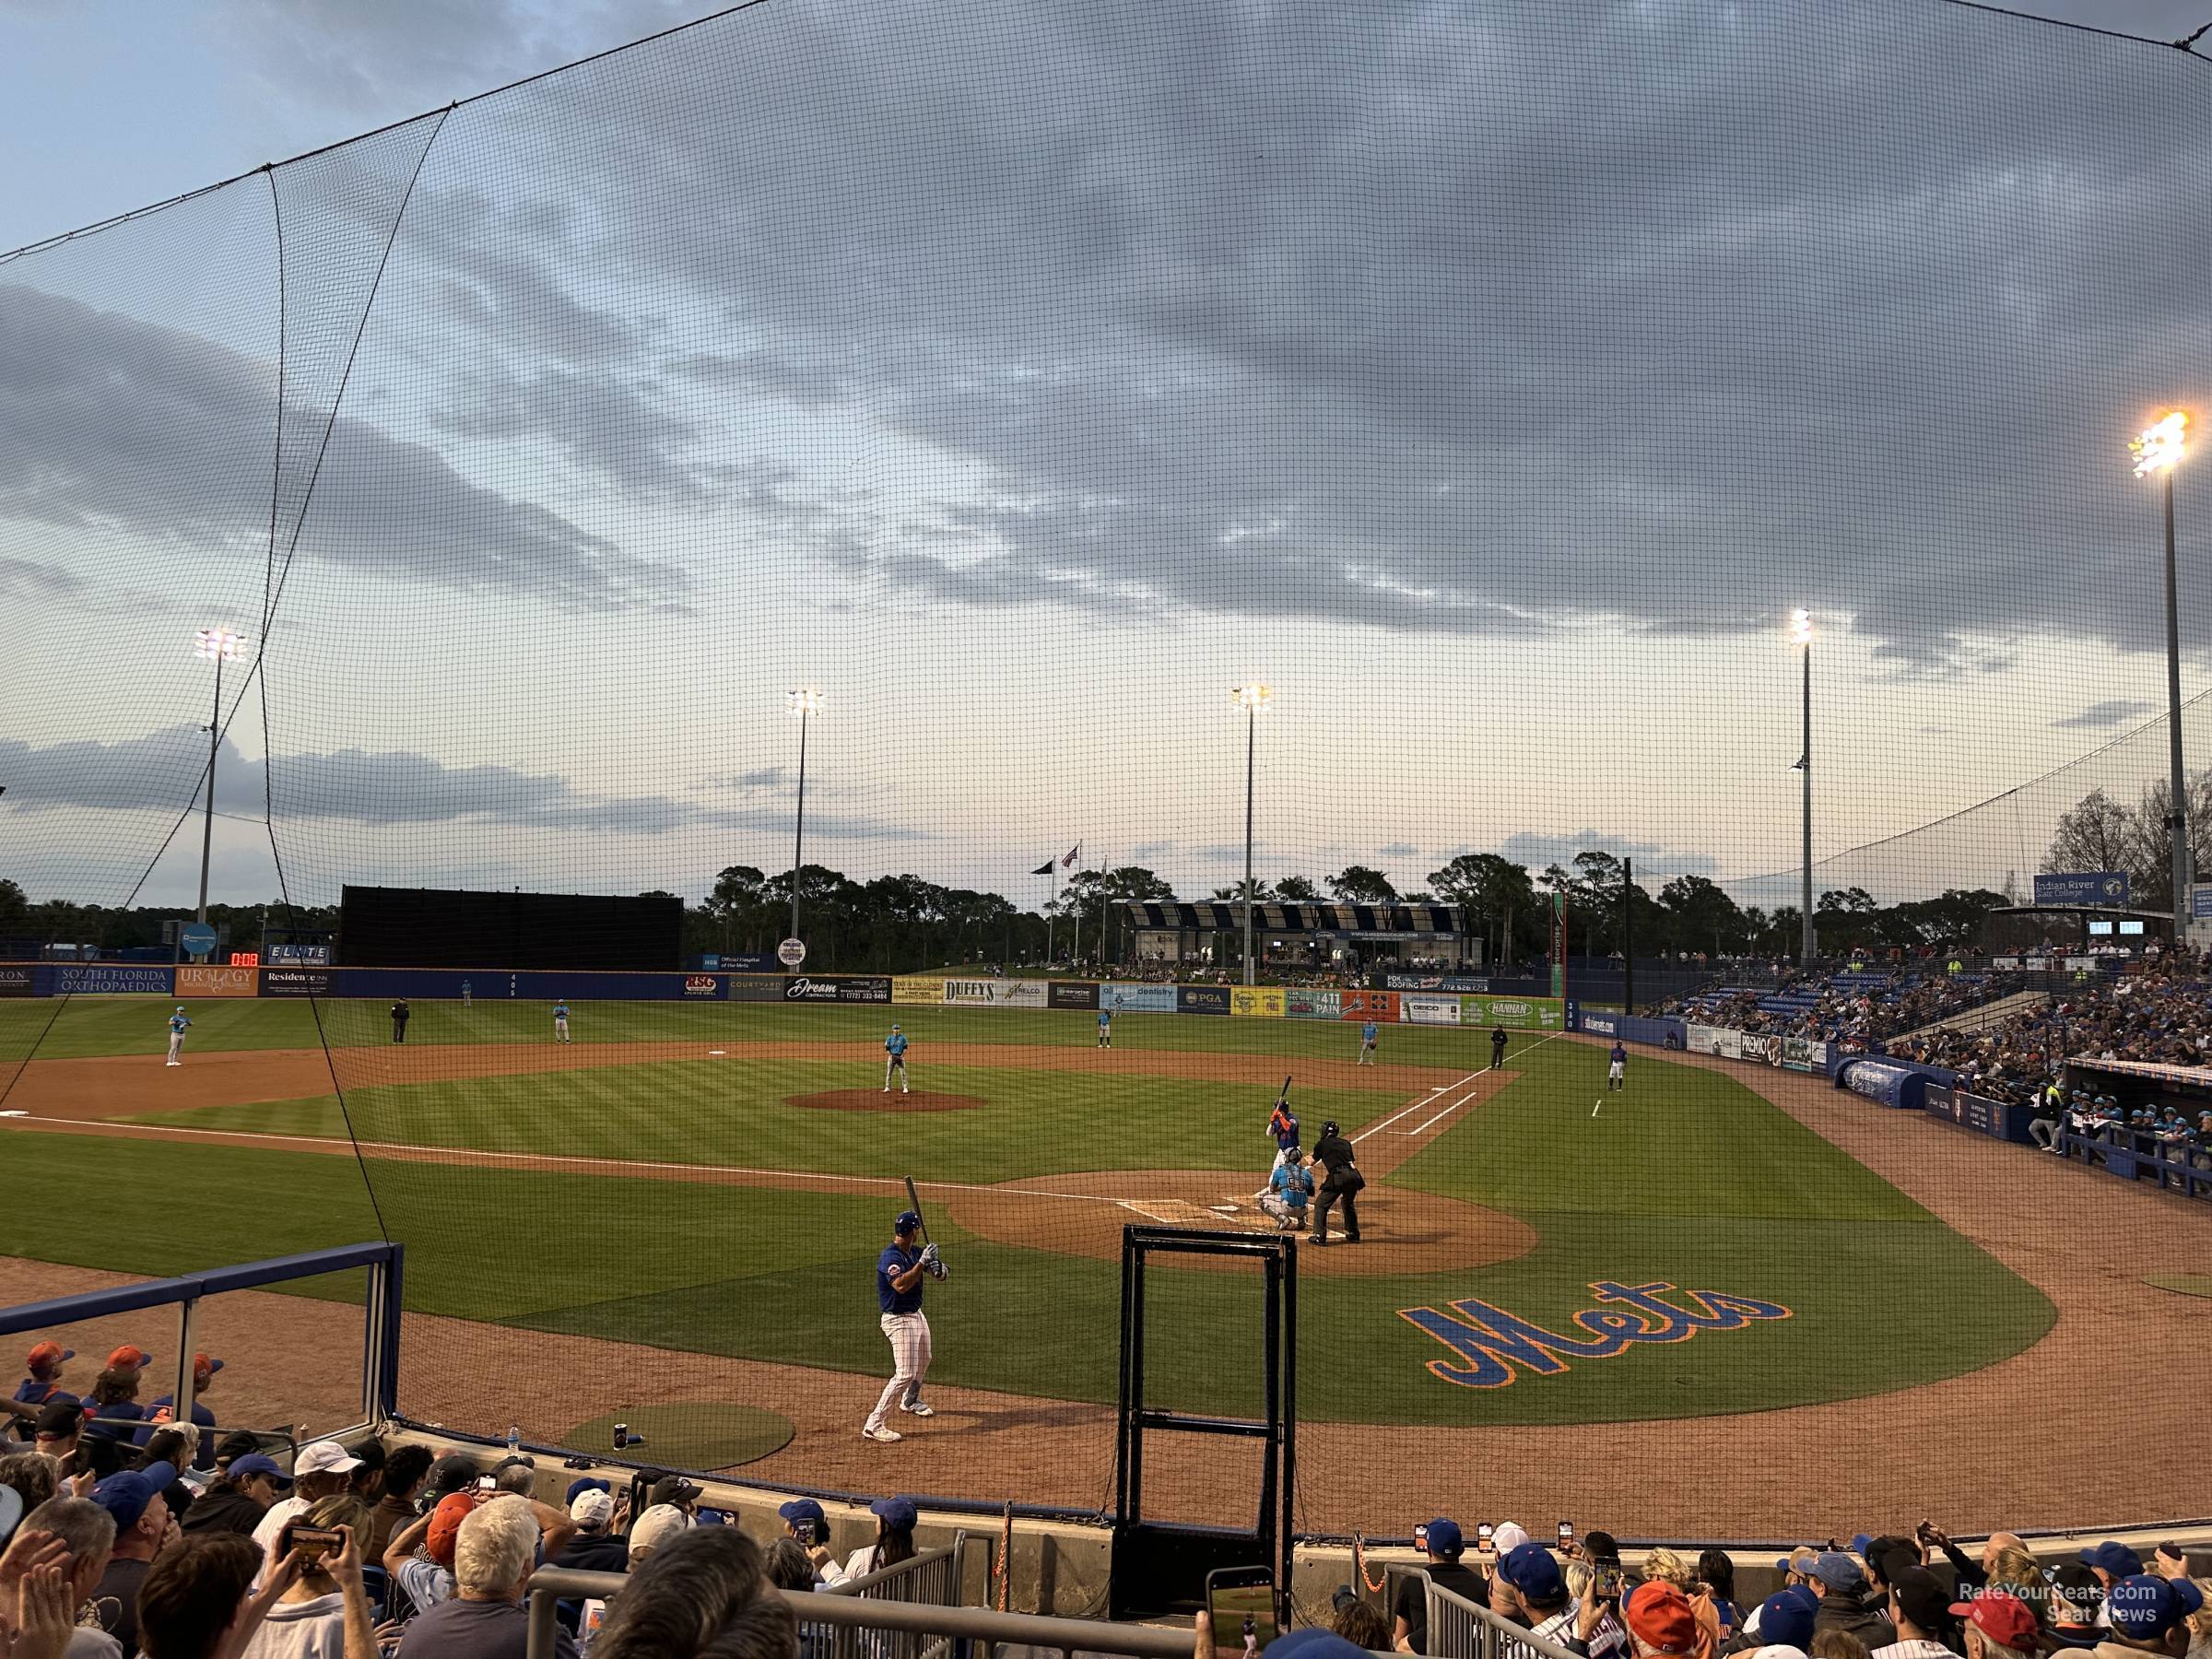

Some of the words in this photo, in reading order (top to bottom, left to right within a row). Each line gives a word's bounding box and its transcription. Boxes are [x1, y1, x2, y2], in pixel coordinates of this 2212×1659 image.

[2036, 882, 2065, 890] Indian
[2054, 888, 2083, 898] College
[231, 953, 258, 967] 0:08
[62, 969, 107, 980] SOUTH
[112, 971, 166, 981] FLORIDA
[61, 981, 167, 992] ORTHOPAEDICS
[787, 978, 837, 997] Dream
[1137, 987, 1172, 996] dentistry
[1198, 994, 1223, 1003] PGA
[1316, 1004, 1340, 1014] PAIN
[1492, 1003, 1527, 1015] HANNAN
[1742, 1034, 1767, 1055] PREMIO
[1396, 1280, 1794, 1389] Mets
